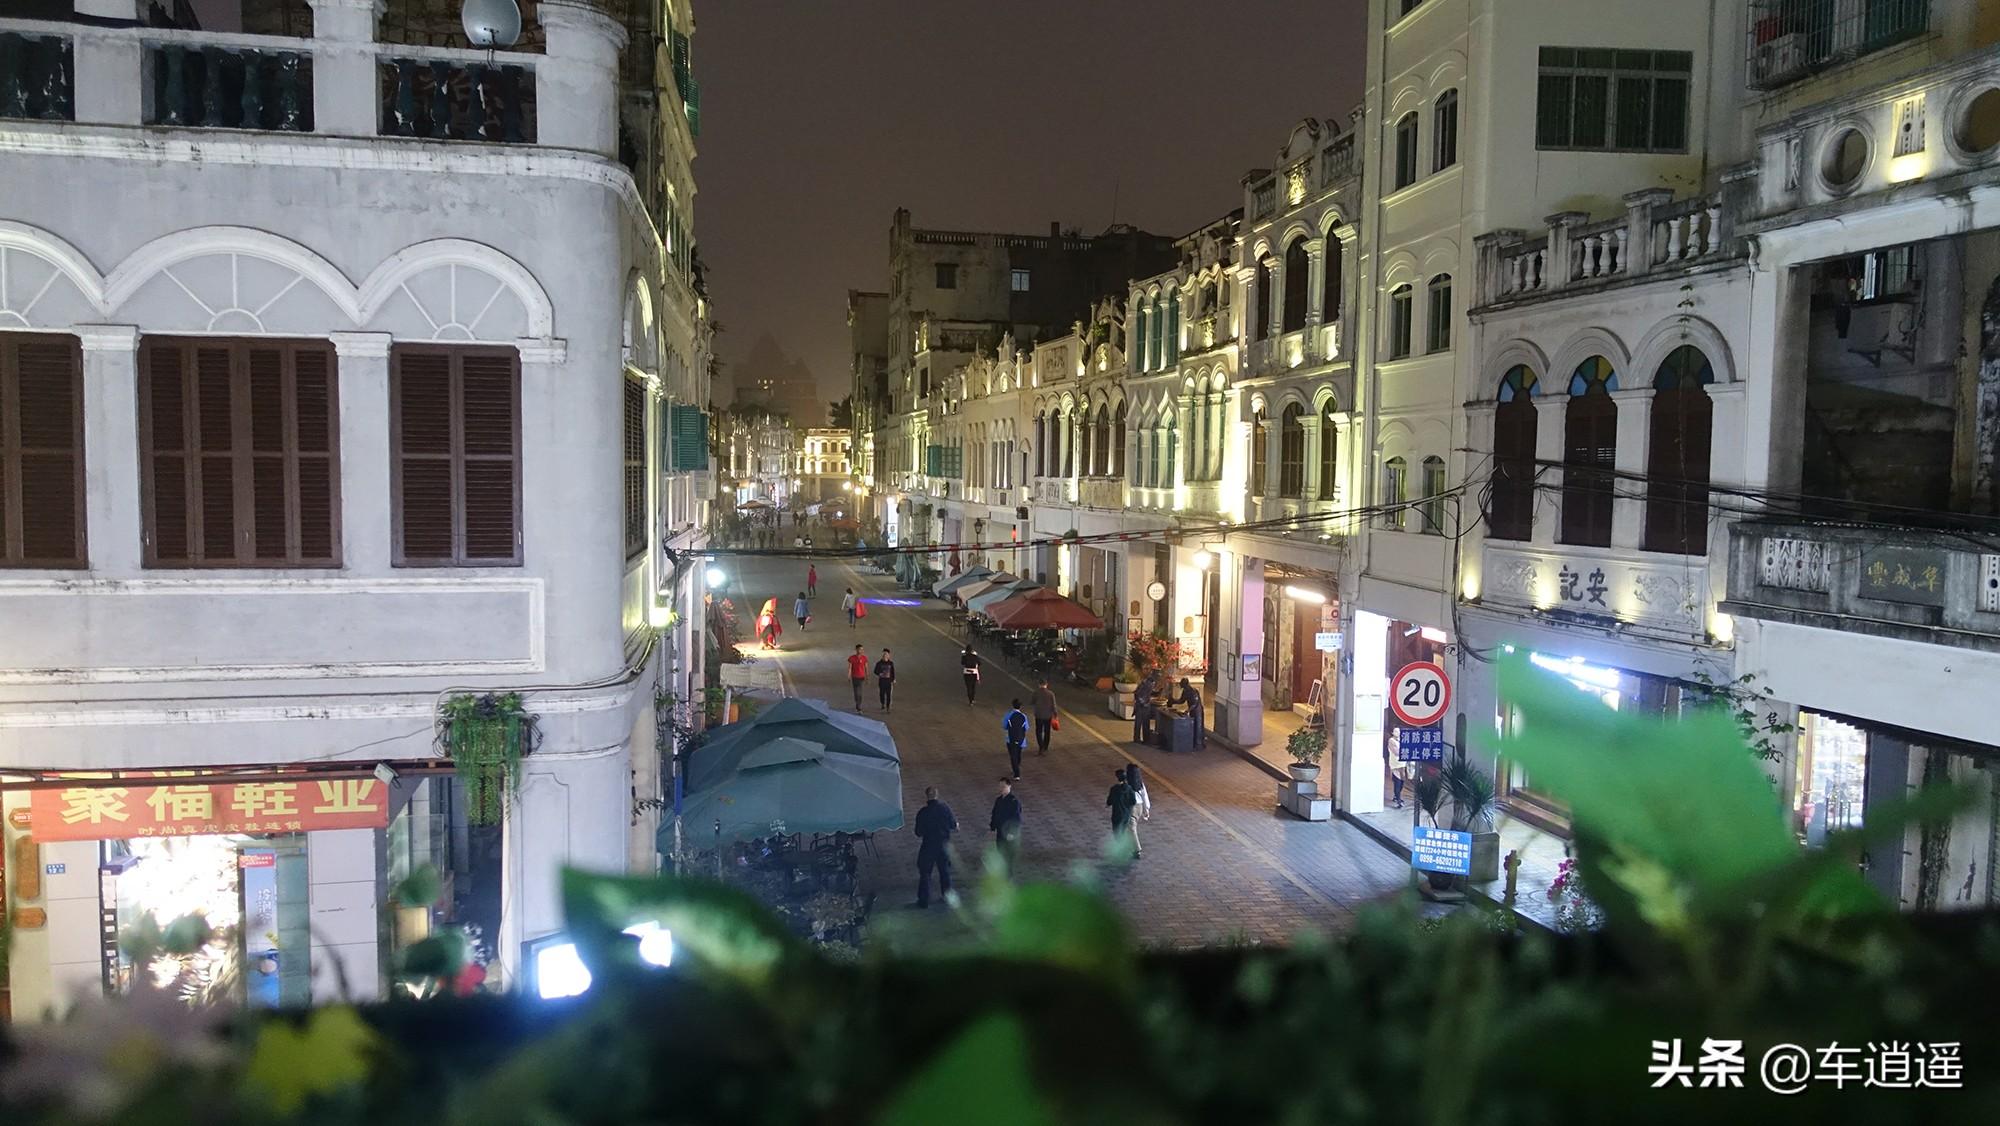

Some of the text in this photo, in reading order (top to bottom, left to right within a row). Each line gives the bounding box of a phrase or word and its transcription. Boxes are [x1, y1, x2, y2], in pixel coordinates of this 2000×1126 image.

[1403, 678, 1440, 707] 20
[1401, 731, 1442, 744] 消防通道
[1400, 747, 1442, 760] 禁止停车
[60, 777, 378, 825] 聚福鞋业
[1426, 830, 1459, 841] 温馨提示
